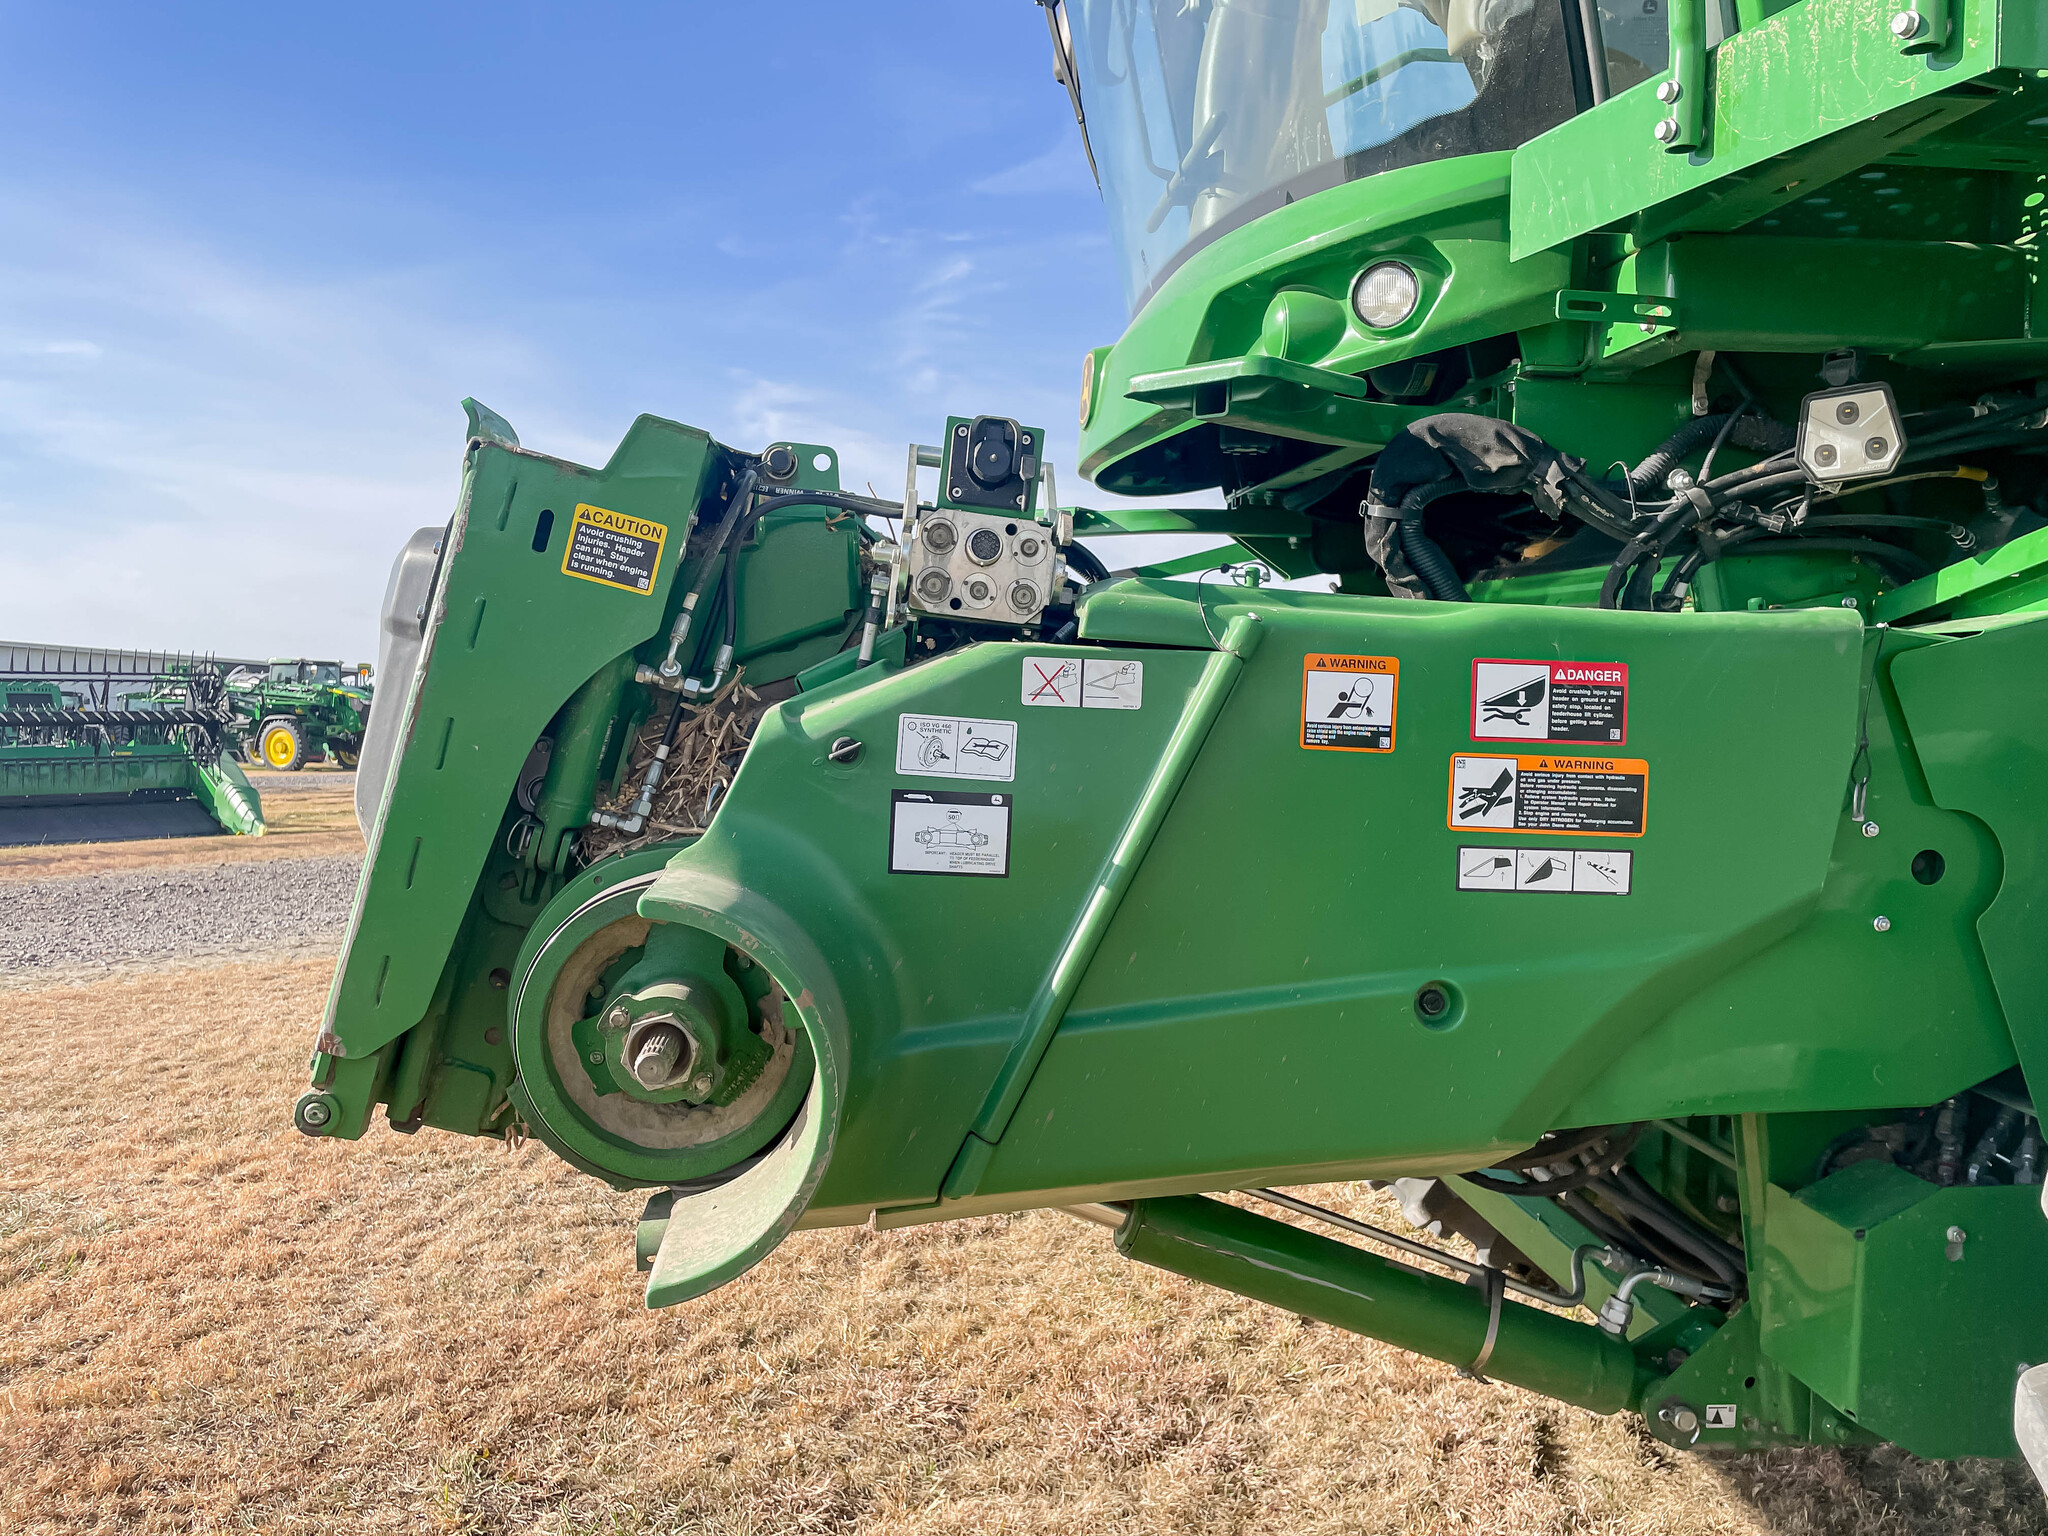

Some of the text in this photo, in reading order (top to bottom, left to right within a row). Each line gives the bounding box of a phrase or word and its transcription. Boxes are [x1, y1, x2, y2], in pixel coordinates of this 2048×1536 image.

[776, 487, 804, 495] WINNER
[593, 512, 662, 539] CAUTION
[578, 534, 645, 557] injuries. Header
[580, 525, 642, 549] Avoid crushing
[575, 544, 629, 564] can tilt. Stay
[573, 552, 648, 577] clear when engine
[580, 563, 615, 578] running.
[1330, 658, 1386, 670] WARNING
[1567, 669, 1621, 682] DANGER
[1554, 759, 1614, 770] WARNING
